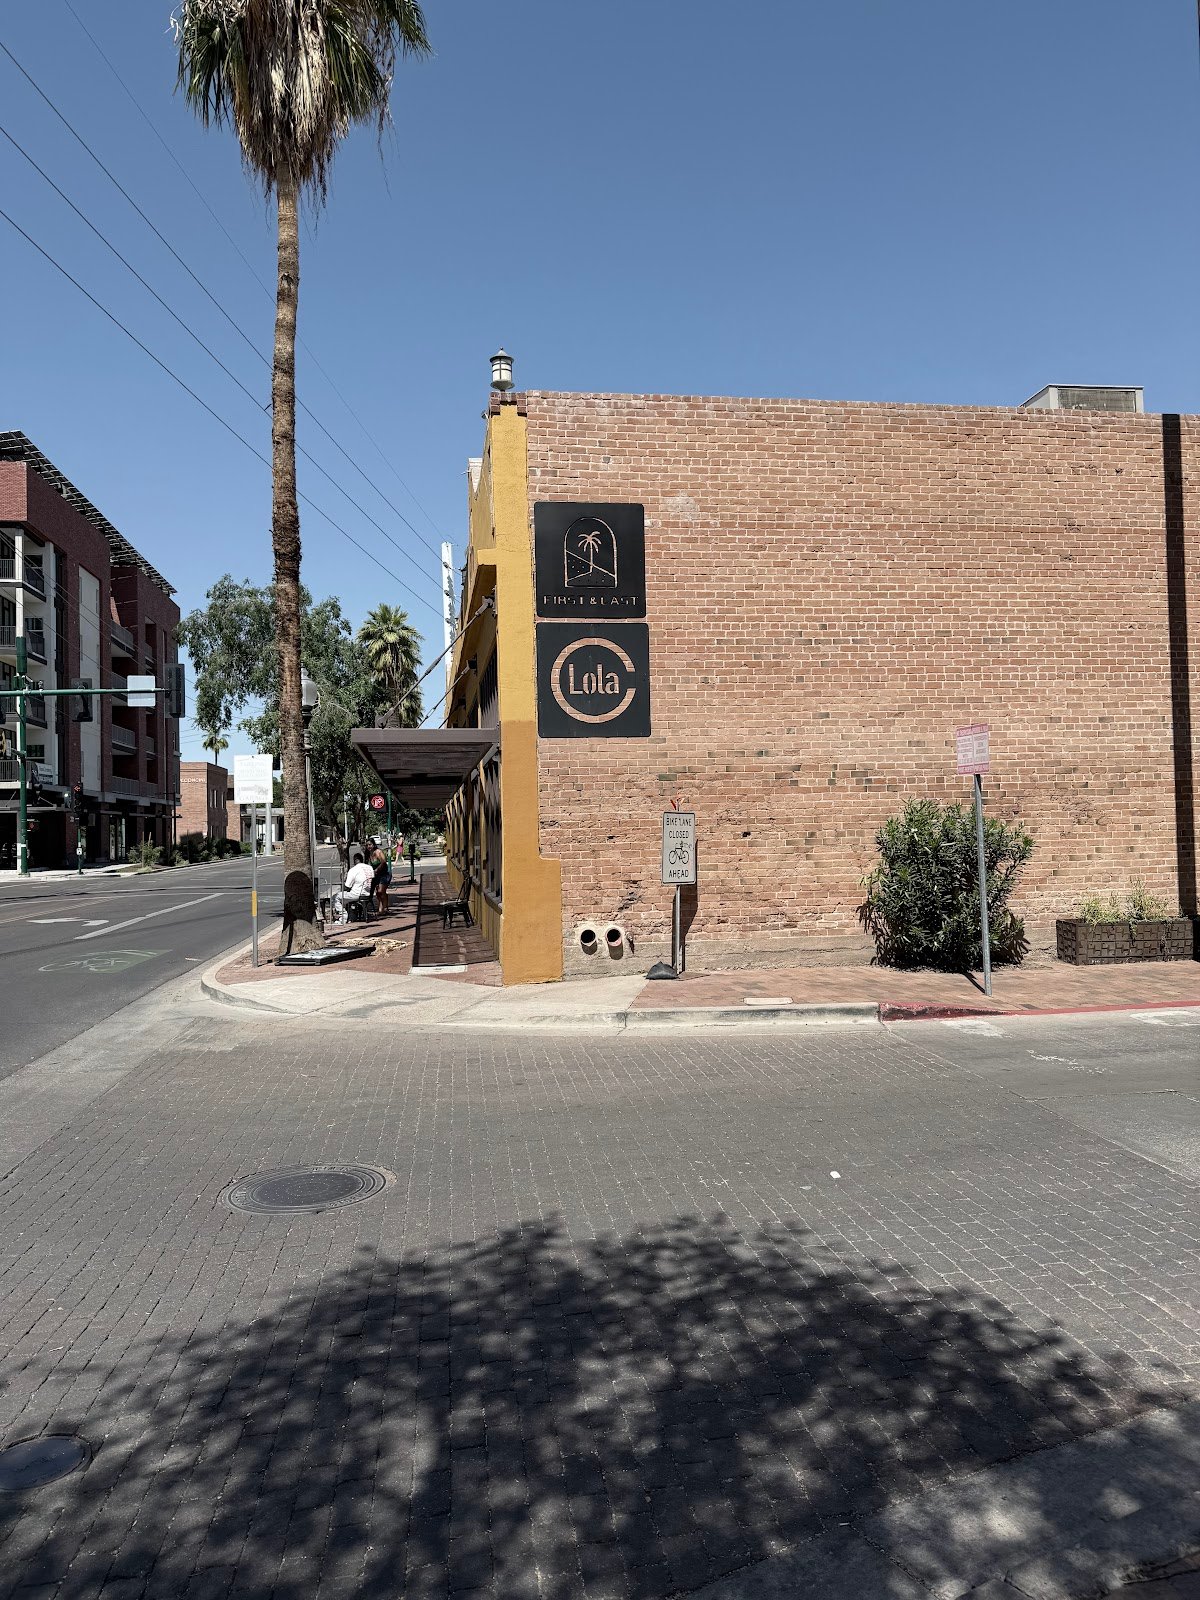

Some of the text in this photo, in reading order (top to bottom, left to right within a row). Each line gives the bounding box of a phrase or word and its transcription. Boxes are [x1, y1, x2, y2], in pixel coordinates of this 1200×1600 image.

[543, 595, 638, 606] FIRST & LAST
[568, 663, 620, 695] Lola
[666, 818, 692, 827] BIKE LANE
[668, 869, 689, 879] AHEAD
